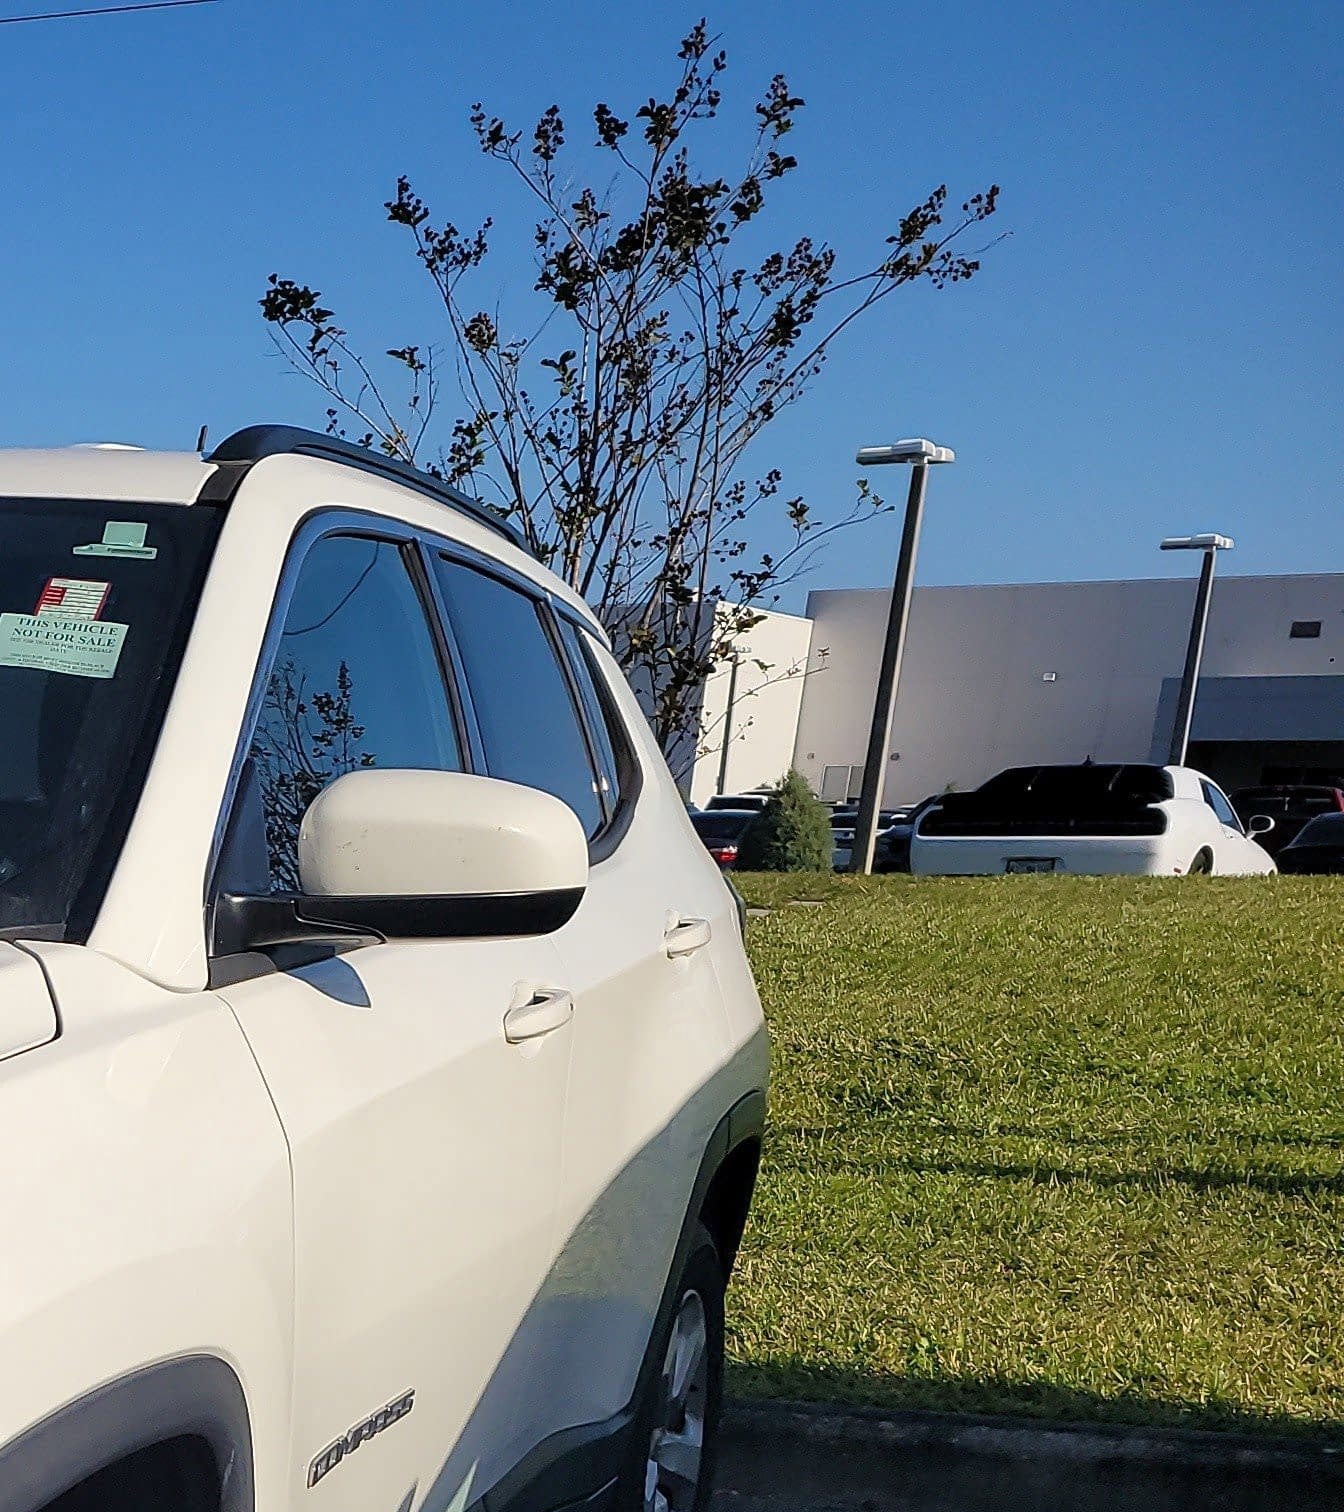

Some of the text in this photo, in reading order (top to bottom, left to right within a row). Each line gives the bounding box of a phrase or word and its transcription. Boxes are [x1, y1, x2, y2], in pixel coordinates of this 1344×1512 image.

[17, 617, 119, 636] THIS VEHICLE
[12, 627, 43, 638] NOT
[45, 631, 75, 643] FOR
[78, 635, 117, 648] SALE
